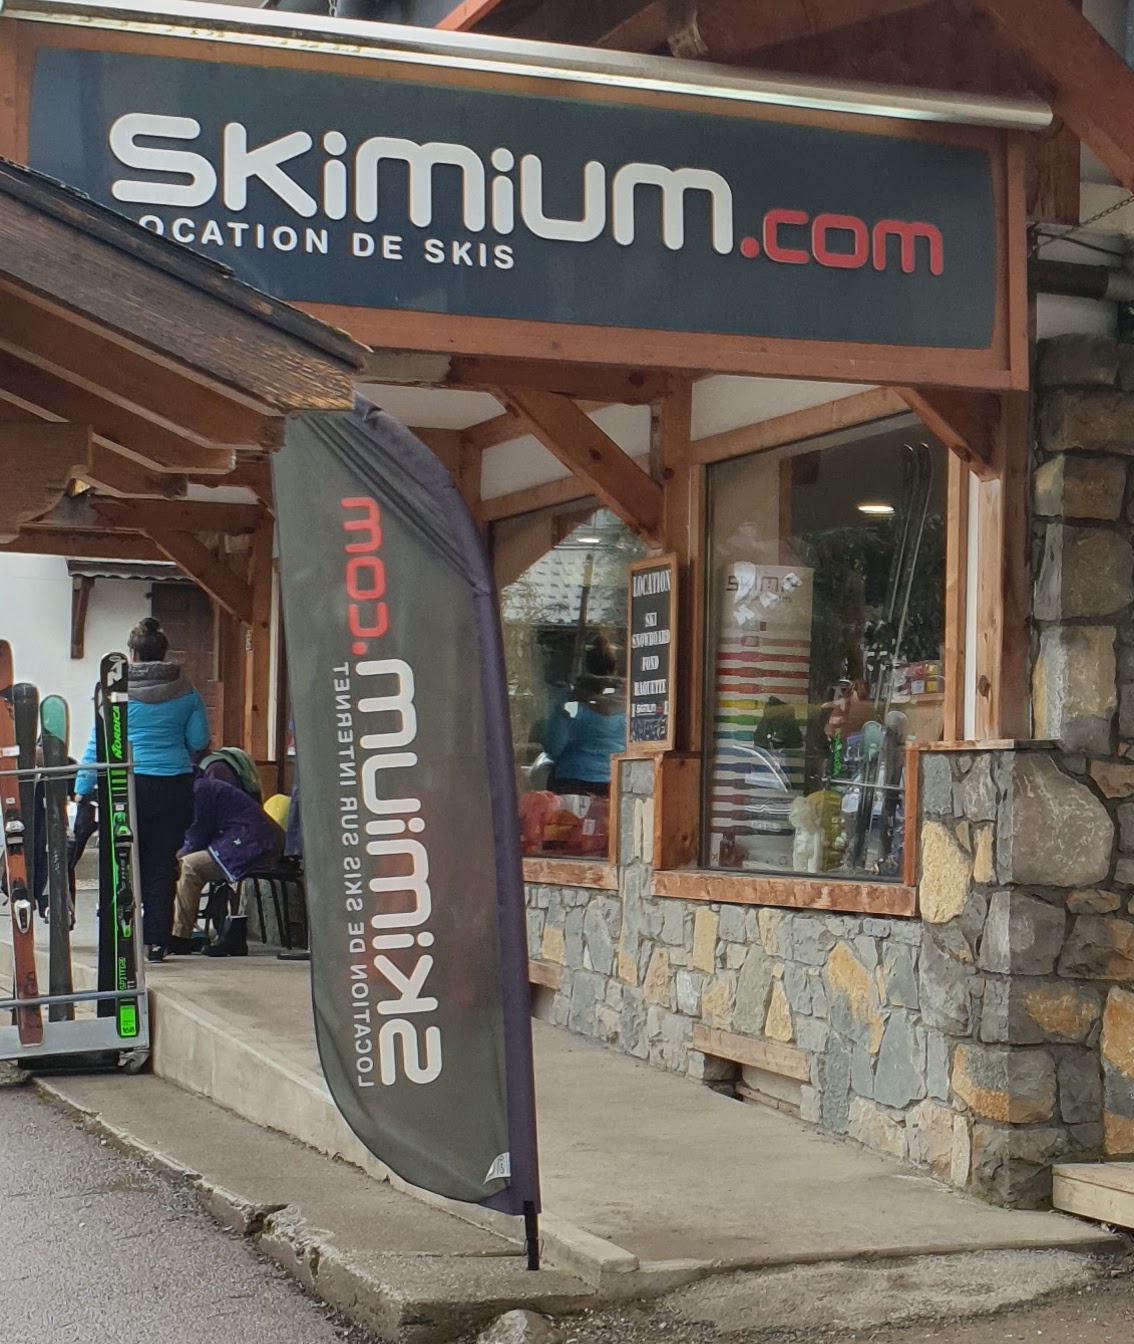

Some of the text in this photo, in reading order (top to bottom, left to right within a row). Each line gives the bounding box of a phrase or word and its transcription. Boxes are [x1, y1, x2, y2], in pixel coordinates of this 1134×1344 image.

[138, 214, 515, 269] OCATION DE SKIS
[632, 569, 672, 598] LOCATION
[645, 612, 658, 628] SKI
